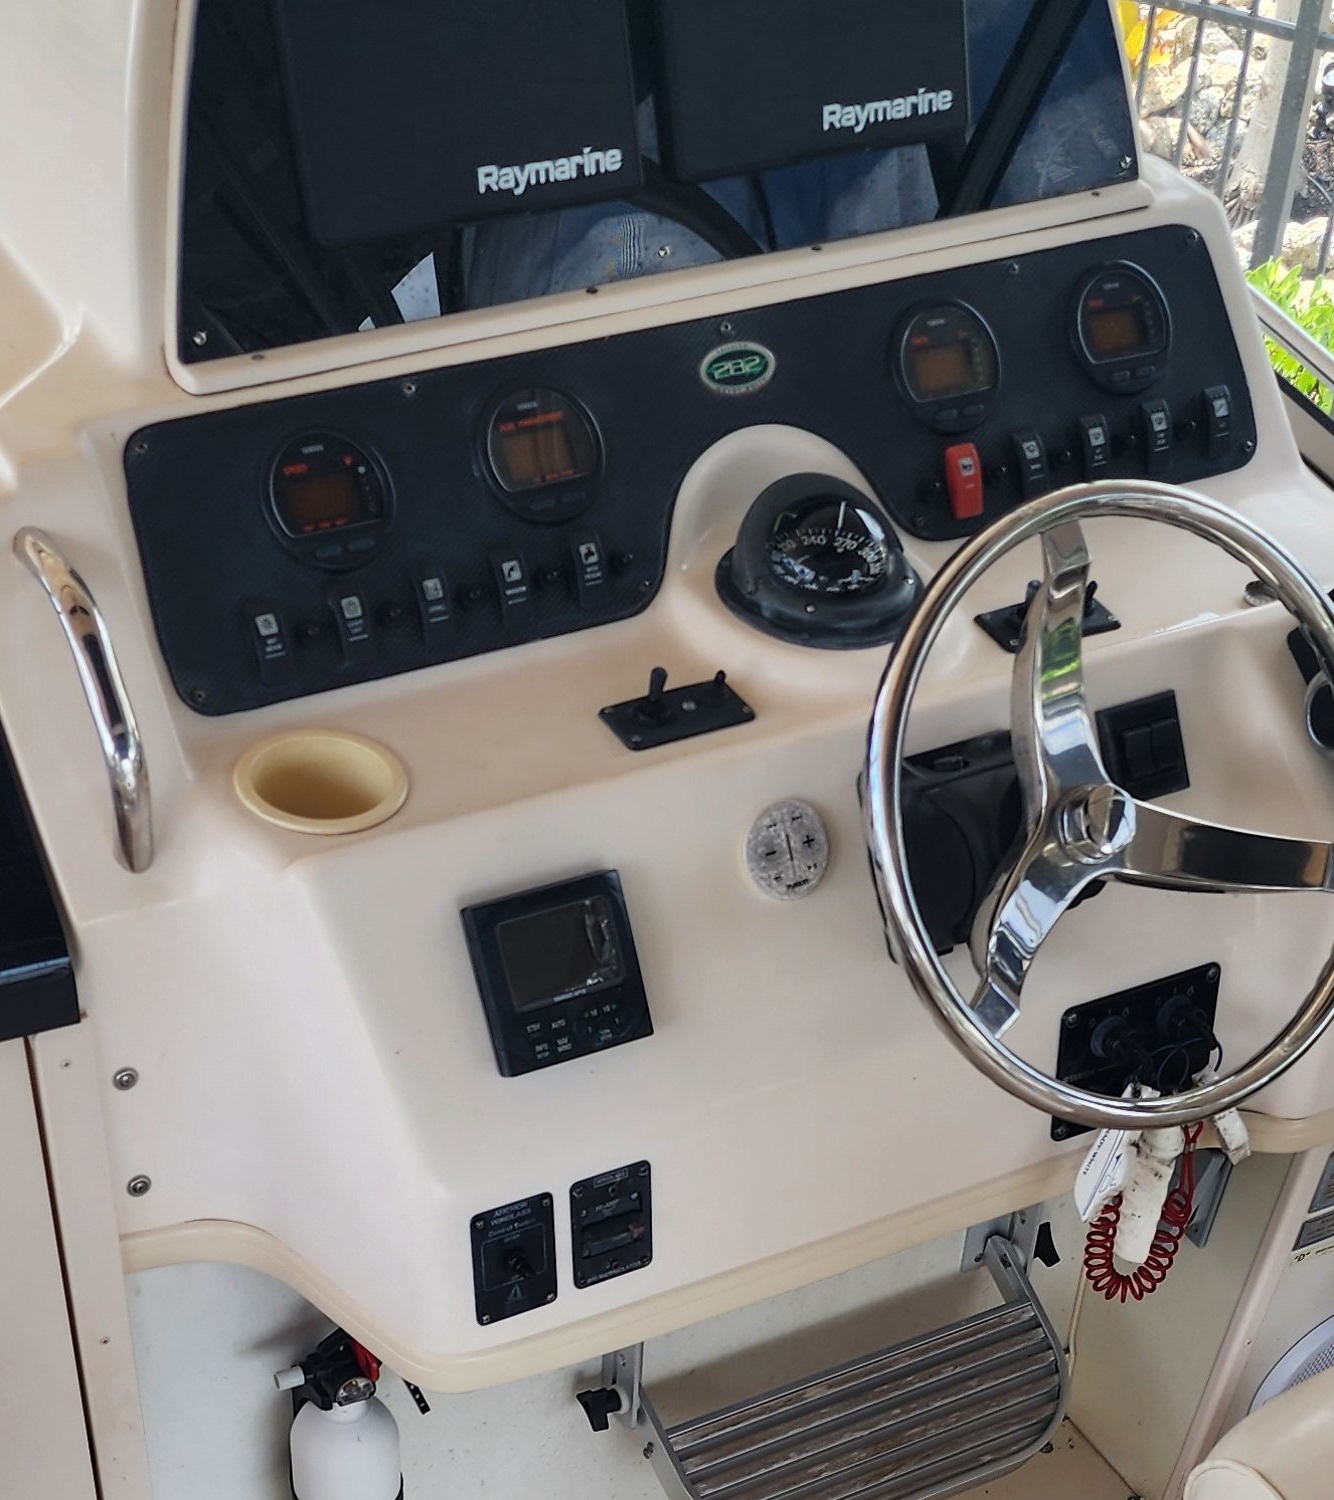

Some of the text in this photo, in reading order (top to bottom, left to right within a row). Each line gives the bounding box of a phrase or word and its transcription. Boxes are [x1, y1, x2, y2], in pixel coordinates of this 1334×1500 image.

[822, 87, 955, 133] Raymarine
[476, 146, 623, 196] Raymarine
[713, 355, 762, 380] 282
[801, 535, 827, 546] 240
[833, 536, 858, 551] 270
